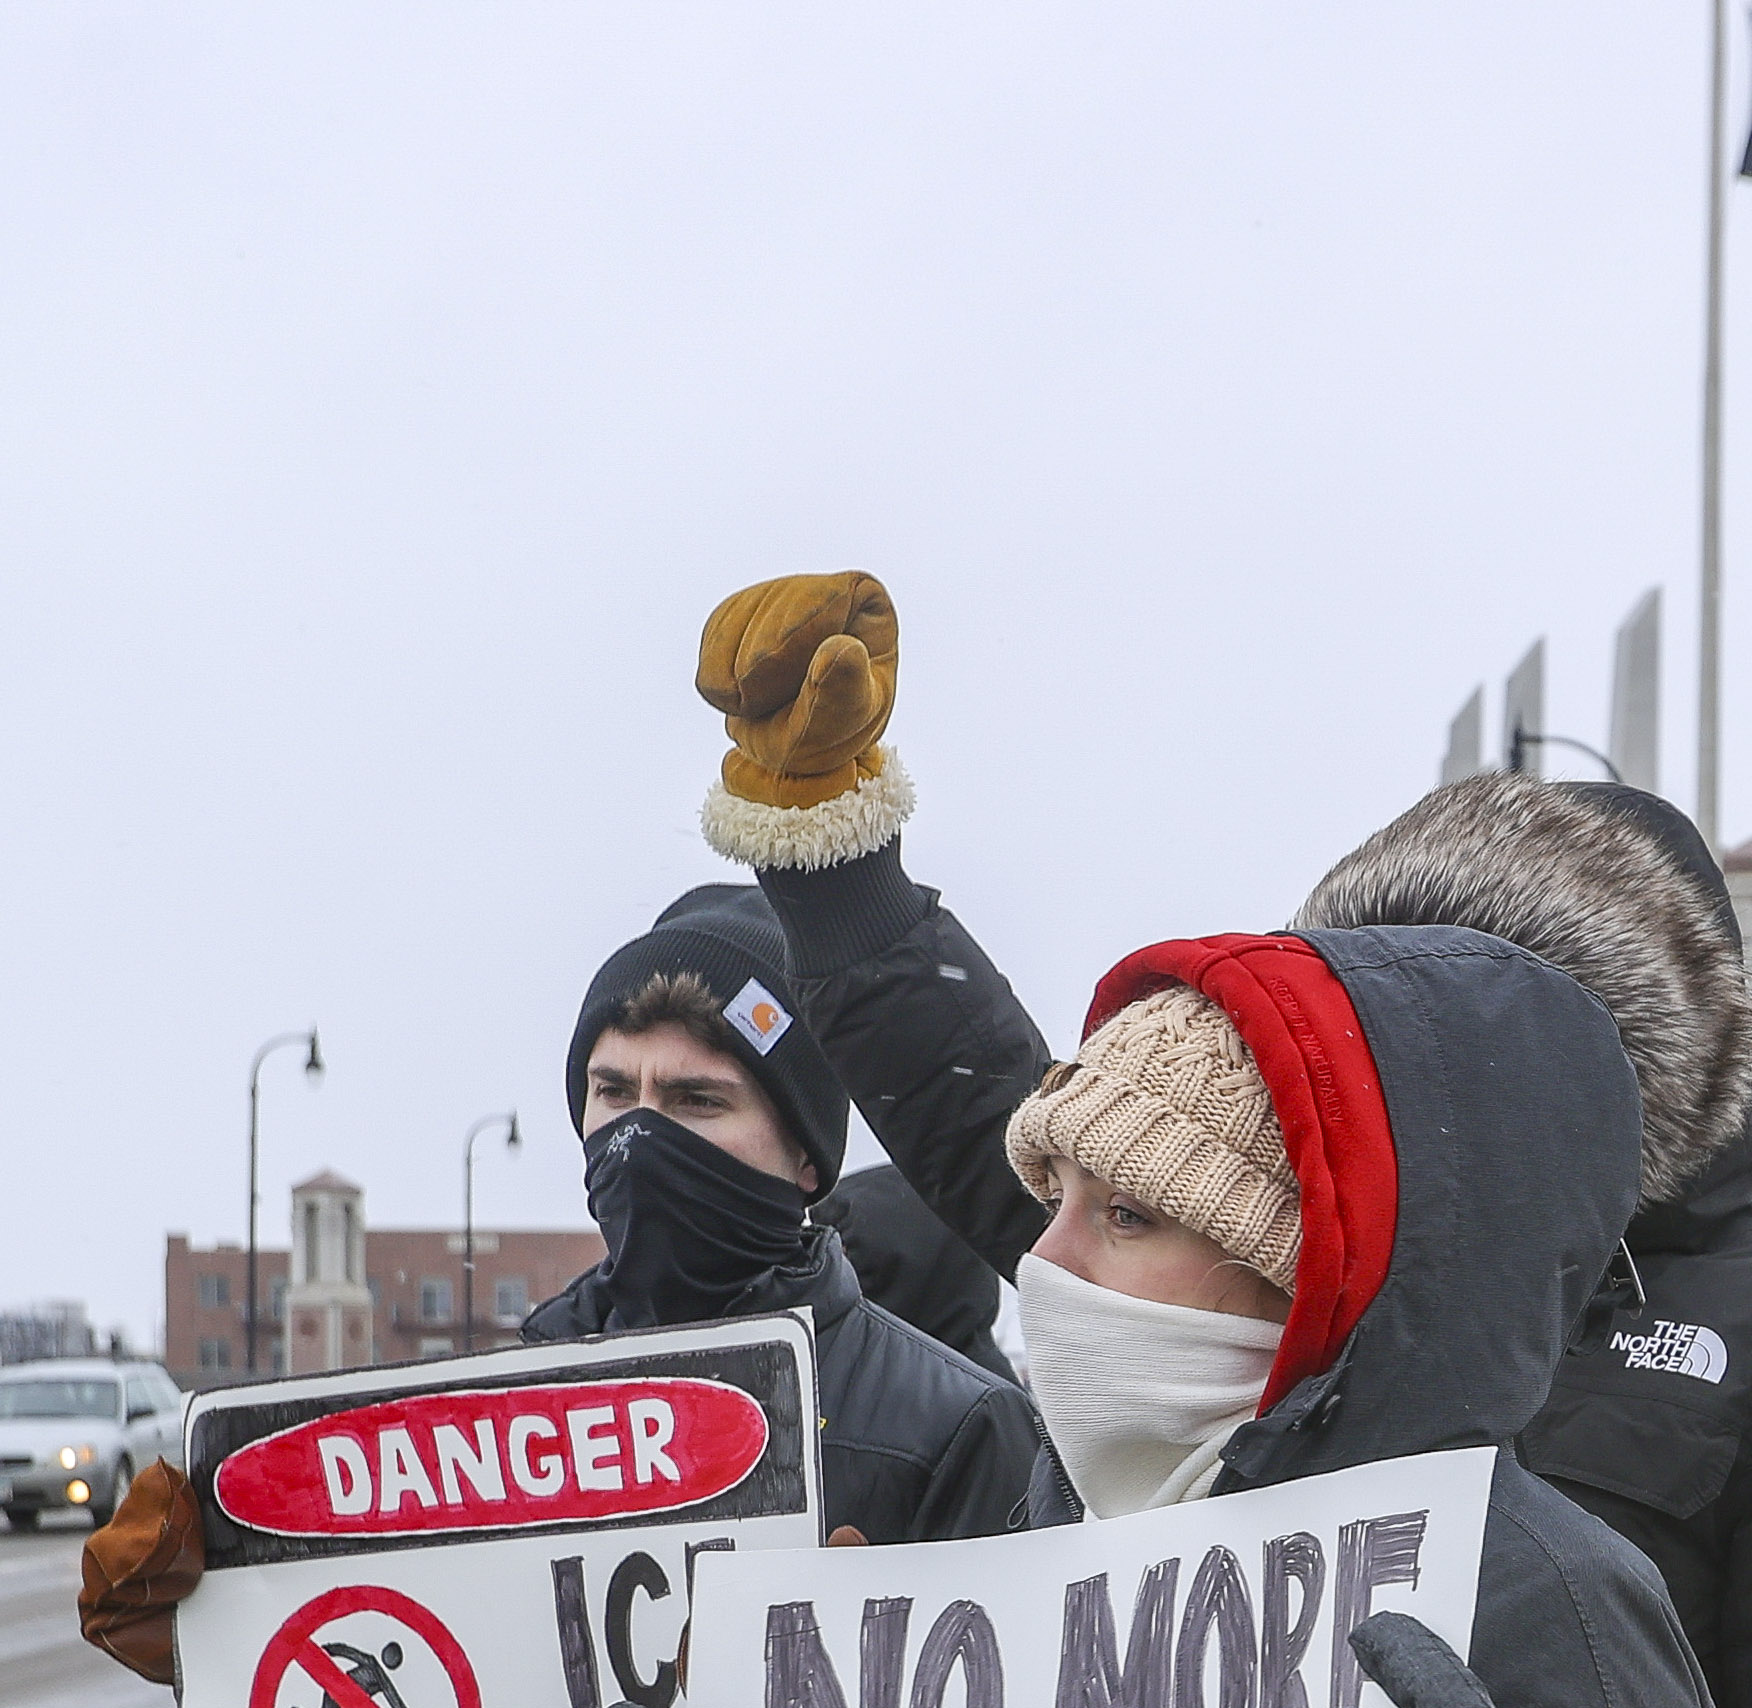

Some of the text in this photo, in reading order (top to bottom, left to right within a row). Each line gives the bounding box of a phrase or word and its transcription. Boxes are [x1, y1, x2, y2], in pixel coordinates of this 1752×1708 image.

[1654, 1320, 1698, 1342] THE
[1610, 1331, 1690, 1358] NORTH
[1625, 1352, 1685, 1373] FACE
[317, 1398, 680, 1516] DANGER
